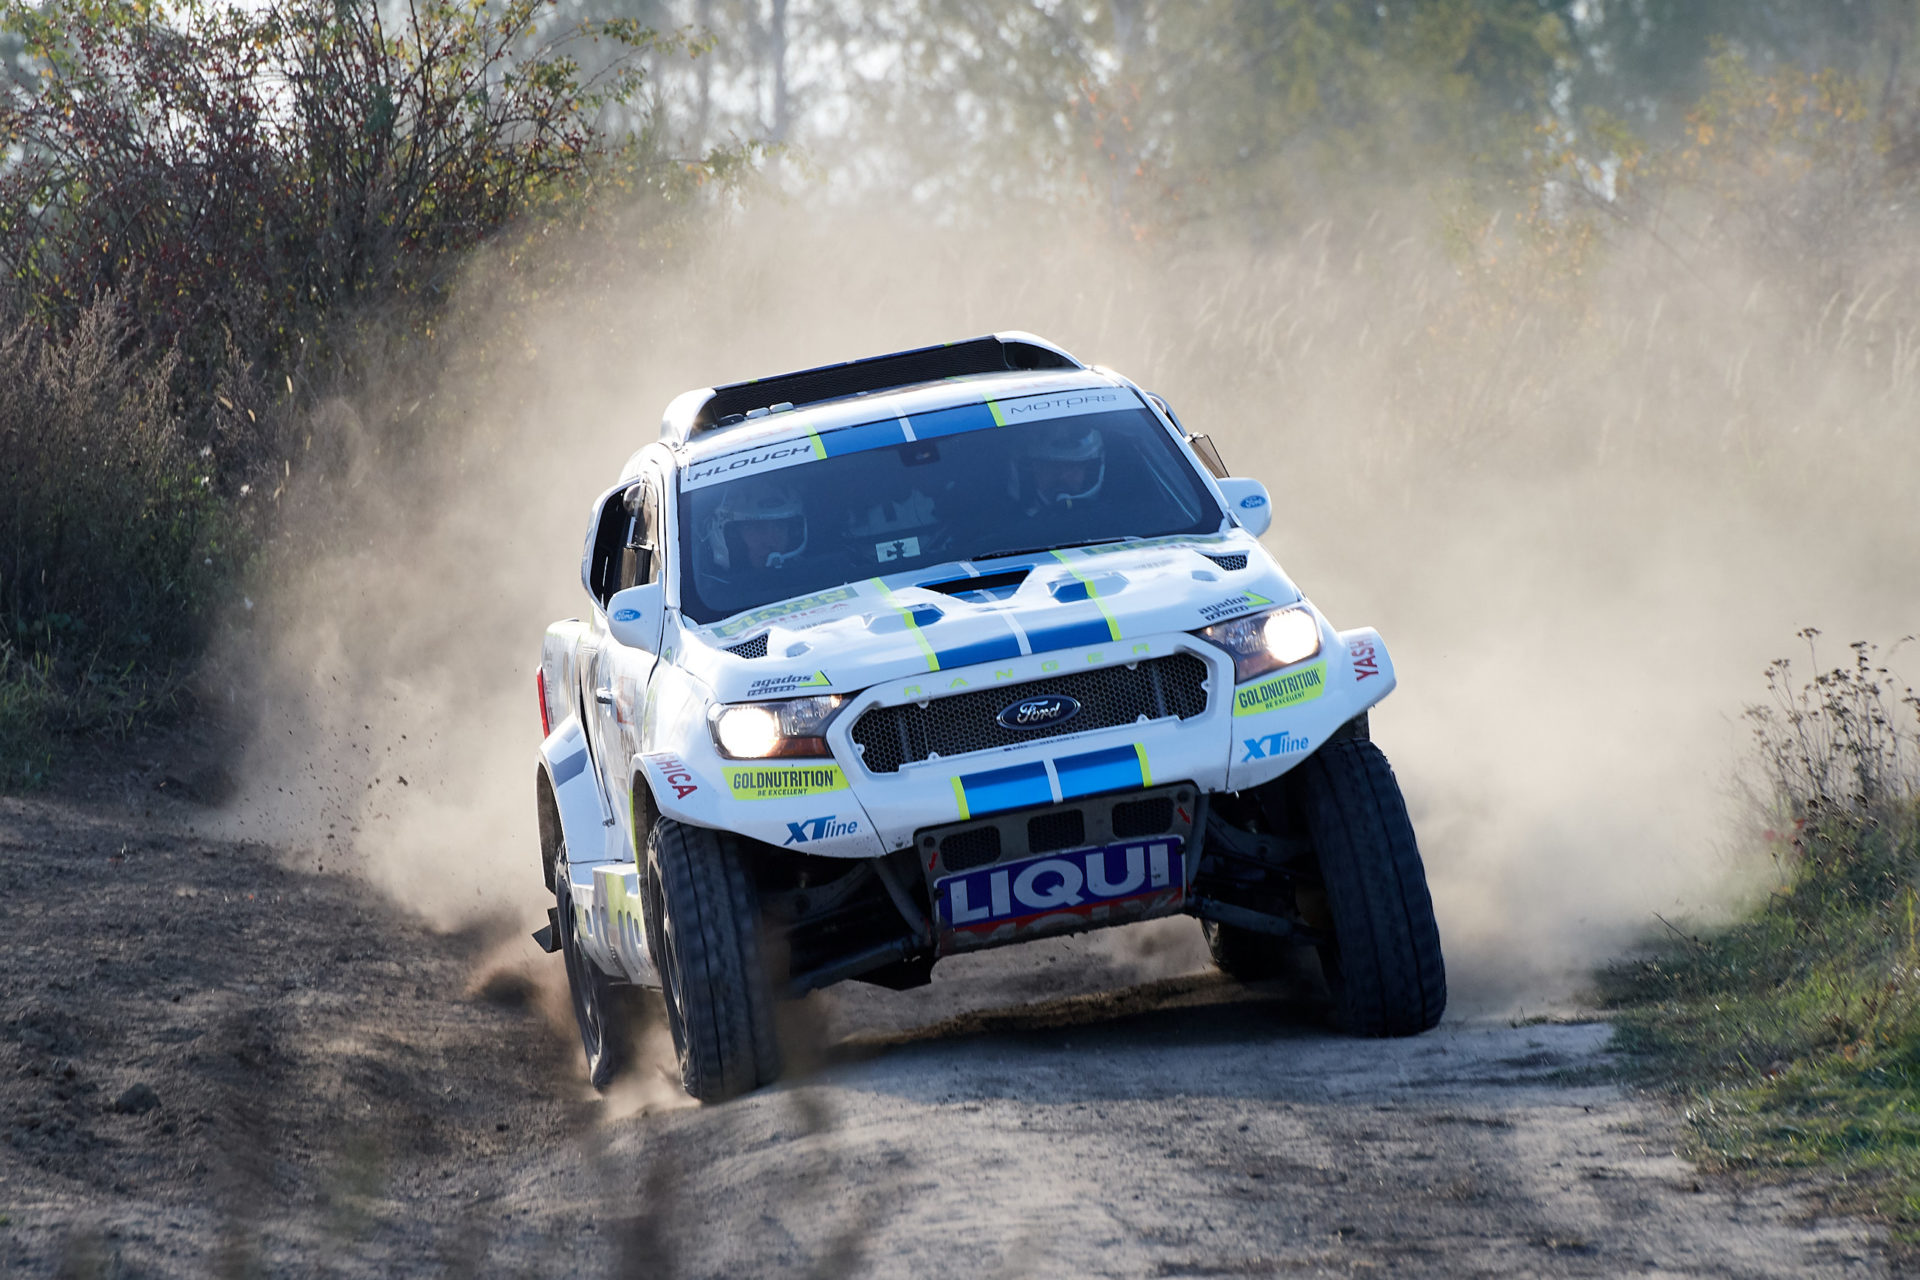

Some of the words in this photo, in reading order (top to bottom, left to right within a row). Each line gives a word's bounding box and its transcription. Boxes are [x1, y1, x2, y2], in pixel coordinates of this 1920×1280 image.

[1010, 394, 1118, 415] MOTORS
[693, 445, 812, 481] HLOUCH
[751, 675, 812, 688] agados
[904, 643, 1150, 697] RANGER
[1238, 669, 1322, 709] GOLDNUTRITION
[1016, 700, 1062, 724] Ford
[733, 770, 834, 790] GOLDNUTRITION
[768, 788, 808, 798] EXCELLENT
[950, 843, 1169, 925] LIQUI
